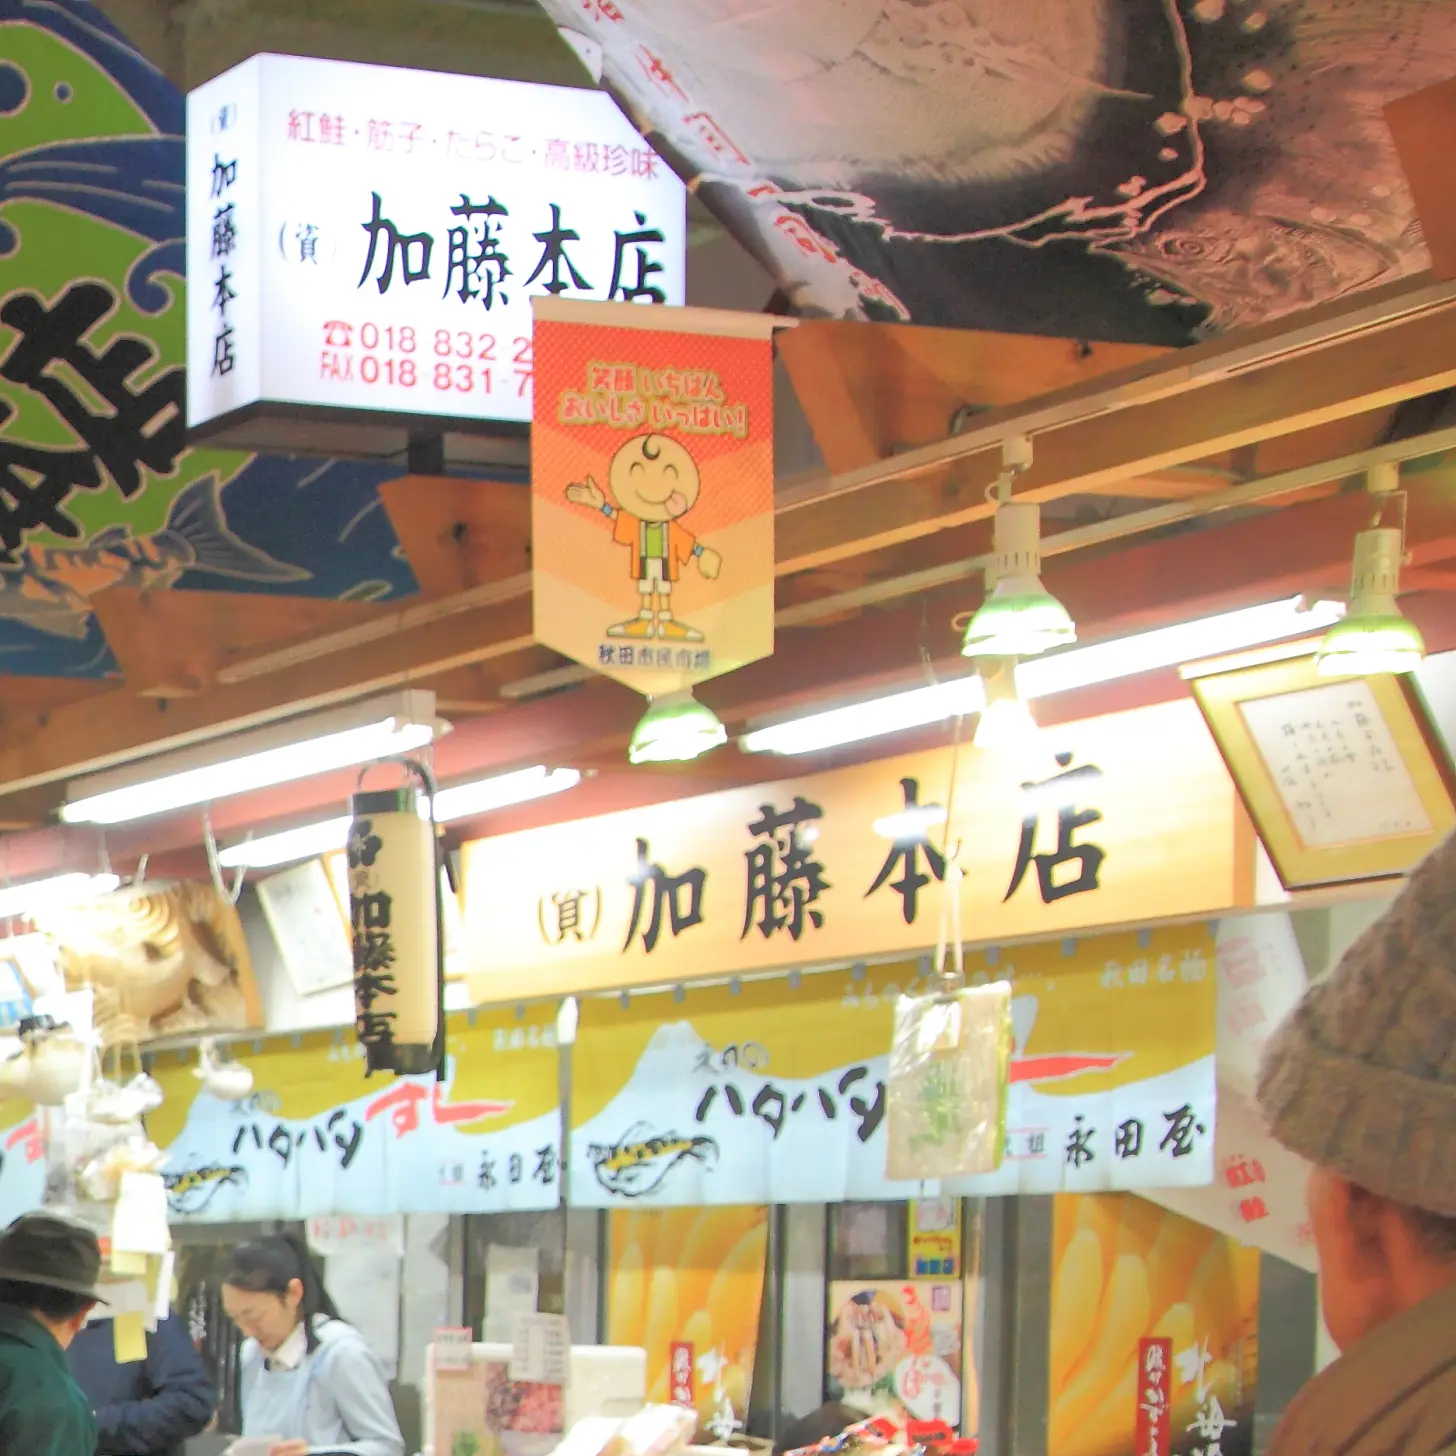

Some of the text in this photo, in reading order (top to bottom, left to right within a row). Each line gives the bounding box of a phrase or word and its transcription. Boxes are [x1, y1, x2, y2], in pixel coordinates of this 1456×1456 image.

[319, 350, 354, 382] FAX
[590, 366, 725, 401] 笑顔 いちばん
[560, 397, 647, 426] おいしさ
[597, 643, 712, 670] 秋田市民市場
[1065, 1104, 1206, 1168] 永田屋
